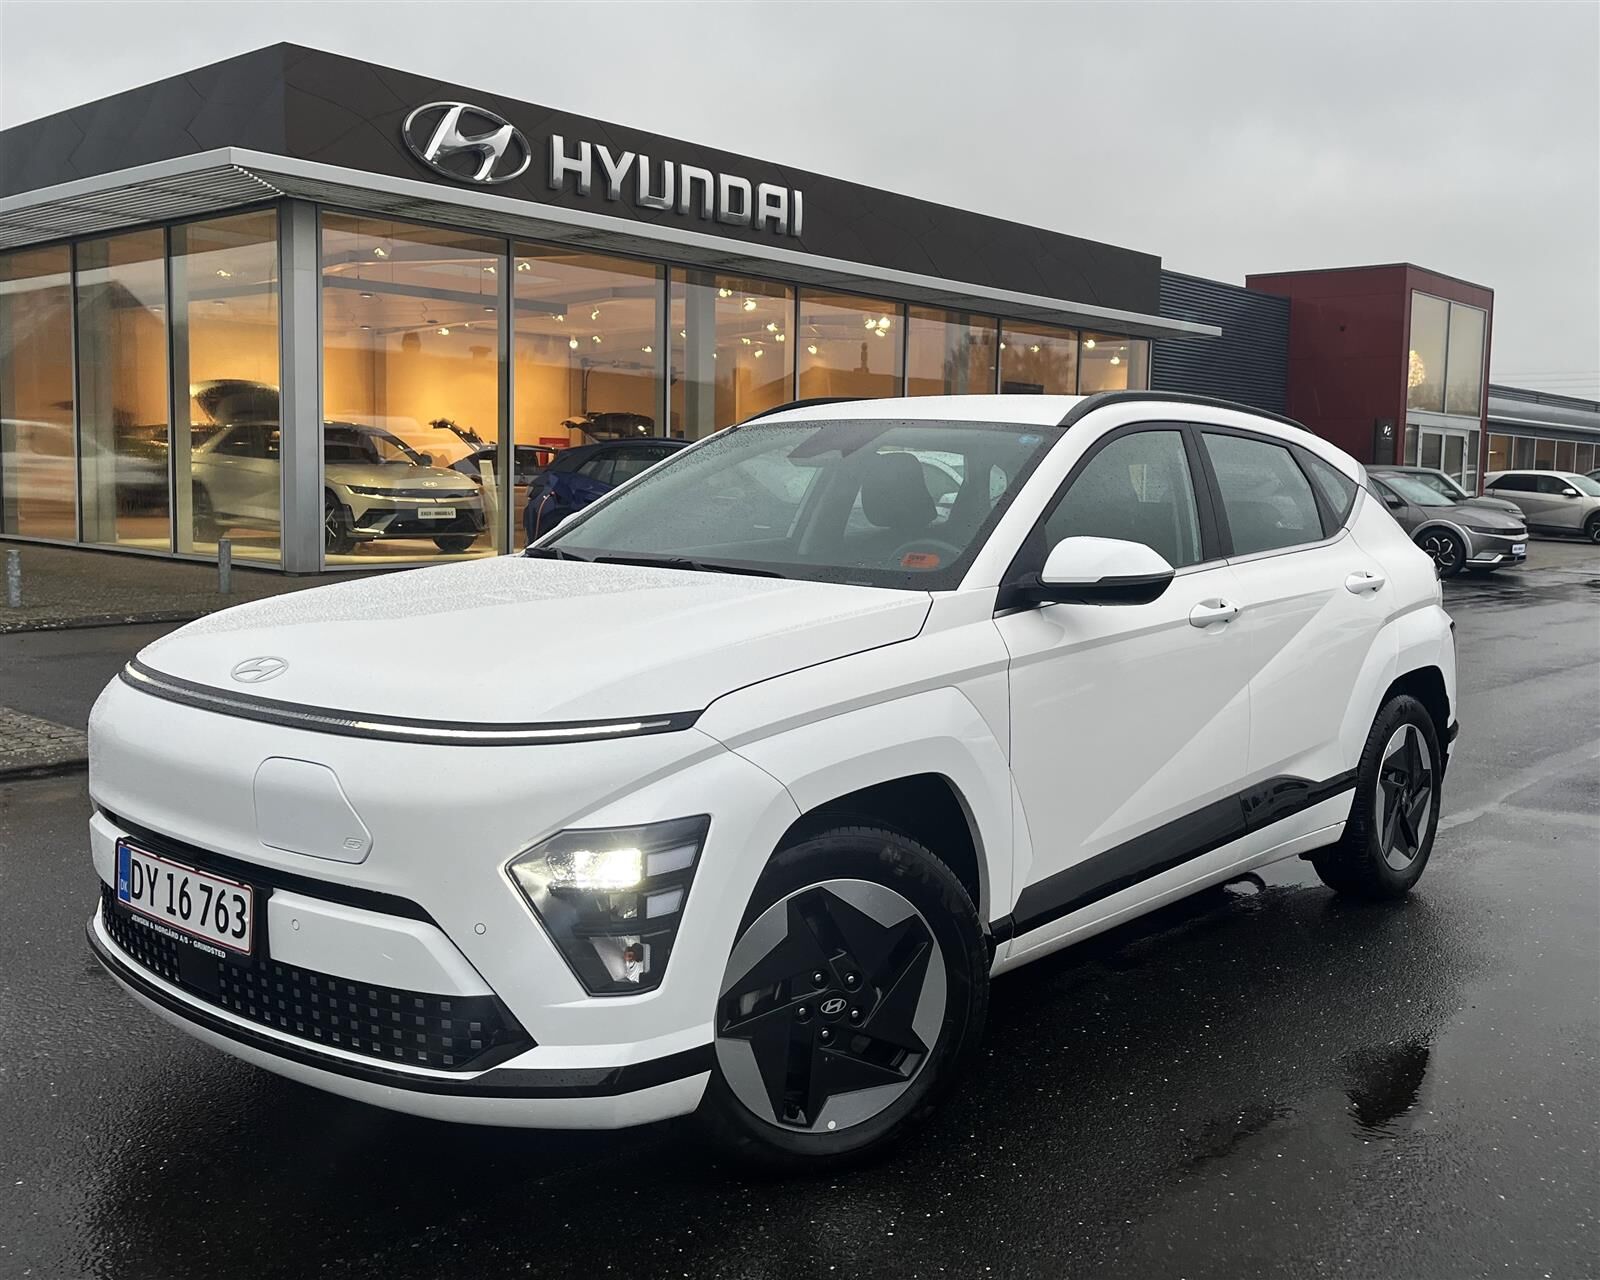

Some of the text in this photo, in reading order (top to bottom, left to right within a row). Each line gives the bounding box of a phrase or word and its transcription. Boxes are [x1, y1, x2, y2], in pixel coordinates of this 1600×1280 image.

[550, 134, 803, 237] HYUNDAI
[120, 879, 129, 893] DK
[131, 858, 247, 939] DY 16 763
[193, 941, 226, 959] GRINDSTED
